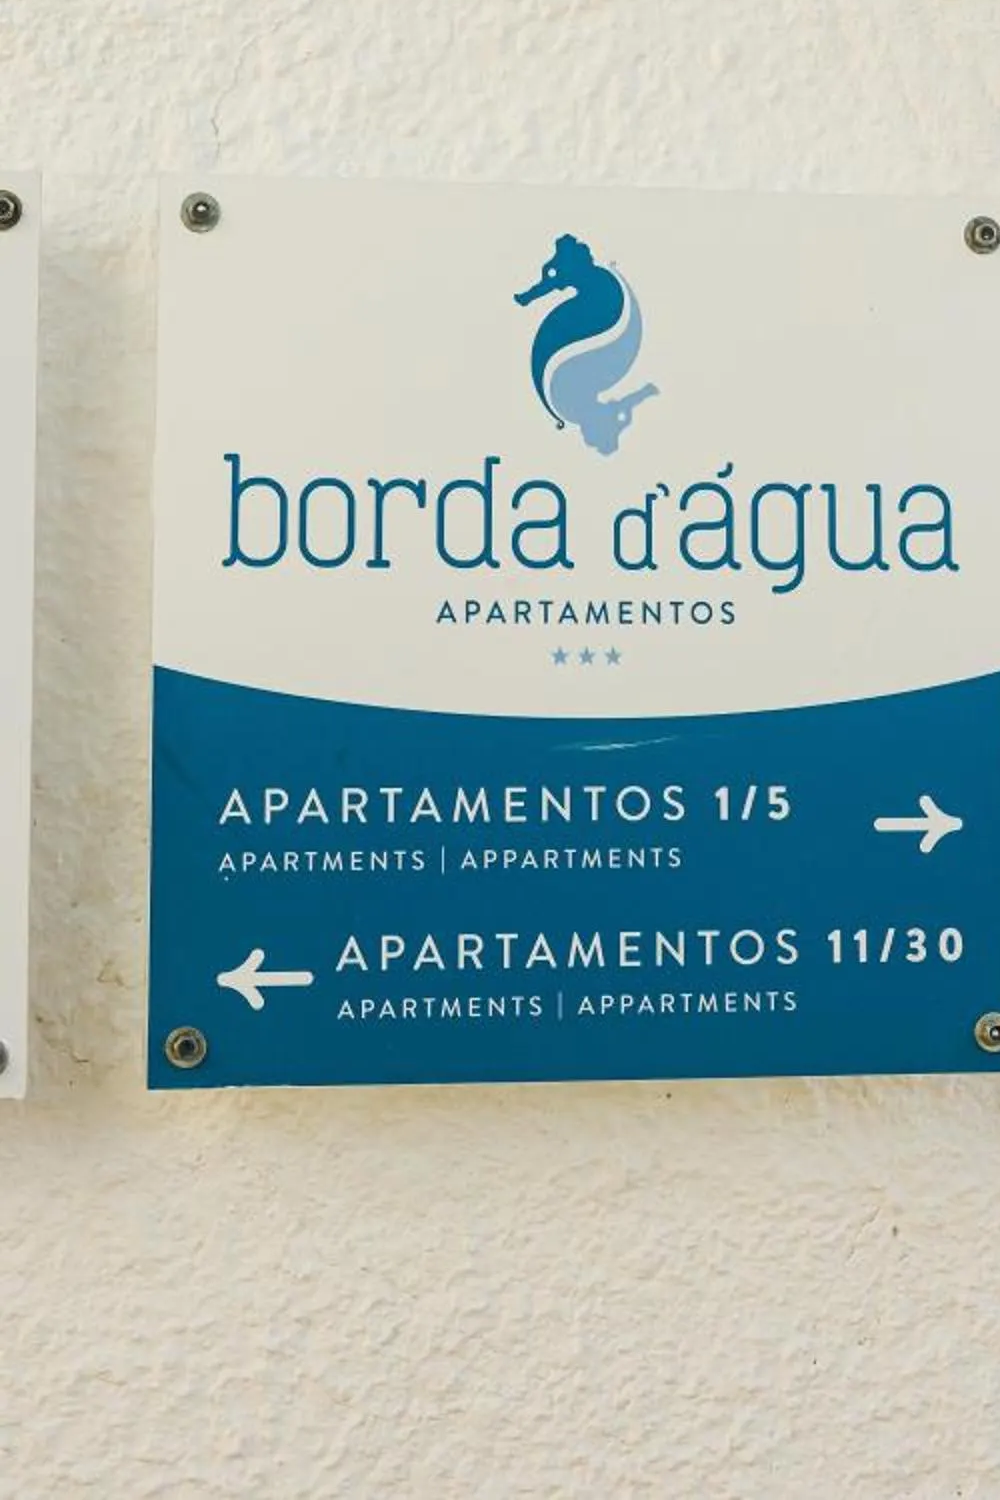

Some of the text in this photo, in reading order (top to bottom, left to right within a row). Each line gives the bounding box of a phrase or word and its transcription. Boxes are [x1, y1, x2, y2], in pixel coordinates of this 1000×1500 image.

[221, 452, 575, 570] borda
[436, 599, 735, 625] APARTAMENTOS
[219, 785, 790, 825] APARTAMENTOS 1/5
[219, 847, 681, 872] APARTMENTS APPARTMENTS
[335, 927, 963, 972] APARTAMENTOS 11/30
[337, 991, 797, 1019] APARTMENTS APPARTMENTS
